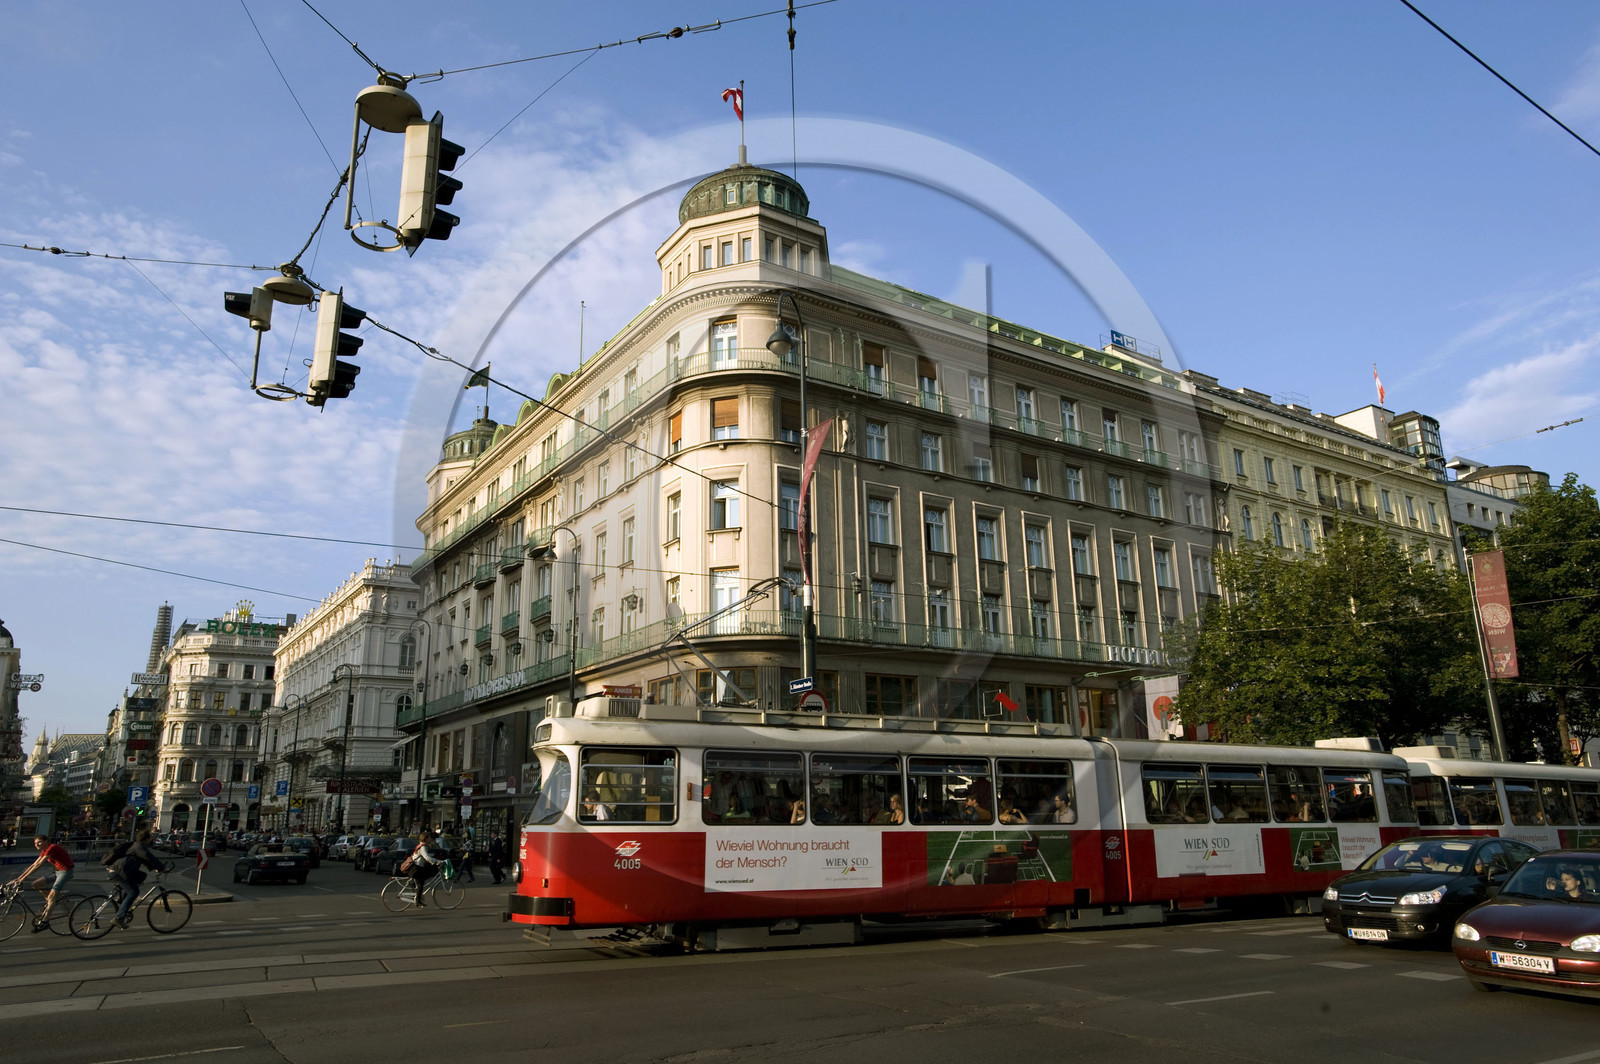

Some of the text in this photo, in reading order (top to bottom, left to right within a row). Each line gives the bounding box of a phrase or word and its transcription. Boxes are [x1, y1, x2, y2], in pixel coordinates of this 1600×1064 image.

[206, 619, 277, 638] ROLEX
[1107, 645, 1161, 666] HOTEL
[130, 722, 152, 731] Gösser
[131, 790, 143, 801] P
[715, 839, 850, 853] Wieviel Wohnung braucht
[1184, 837, 1230, 849] WIEN SÜD
[1105, 850, 1121, 860] 4005
[613, 858, 641, 870] 4005
[715, 856, 787, 869] der Mensch?
[825, 857, 869, 867] WIEN SÜD
[1498, 954, 1550, 969] W 56304 V
